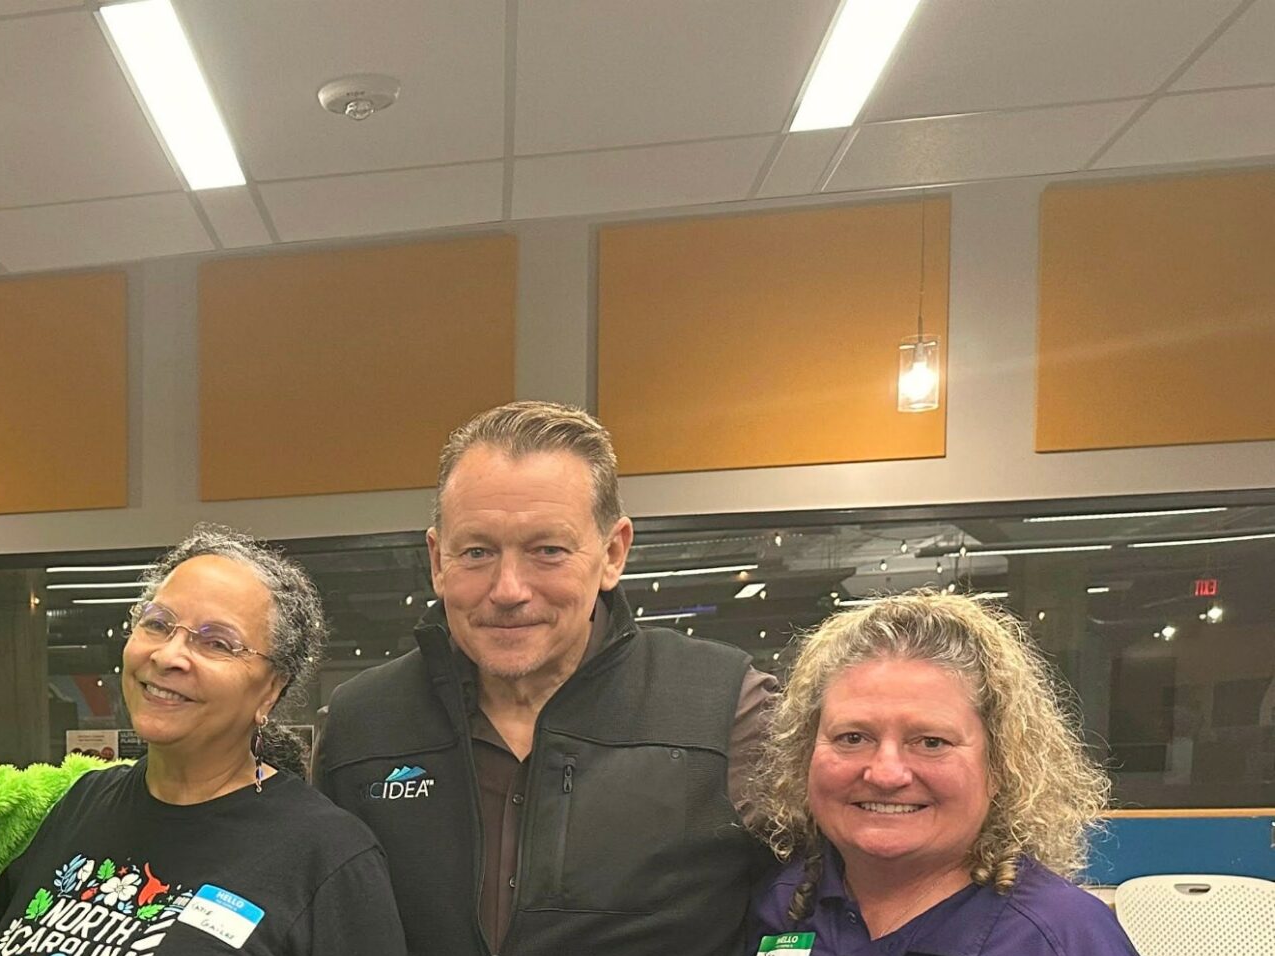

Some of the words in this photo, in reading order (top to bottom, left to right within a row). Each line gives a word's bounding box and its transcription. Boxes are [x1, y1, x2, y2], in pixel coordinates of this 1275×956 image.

[216, 890, 245, 909] HELLO
[39, 898, 142, 945] NORTH
[775, 935, 799, 945] HELLO
